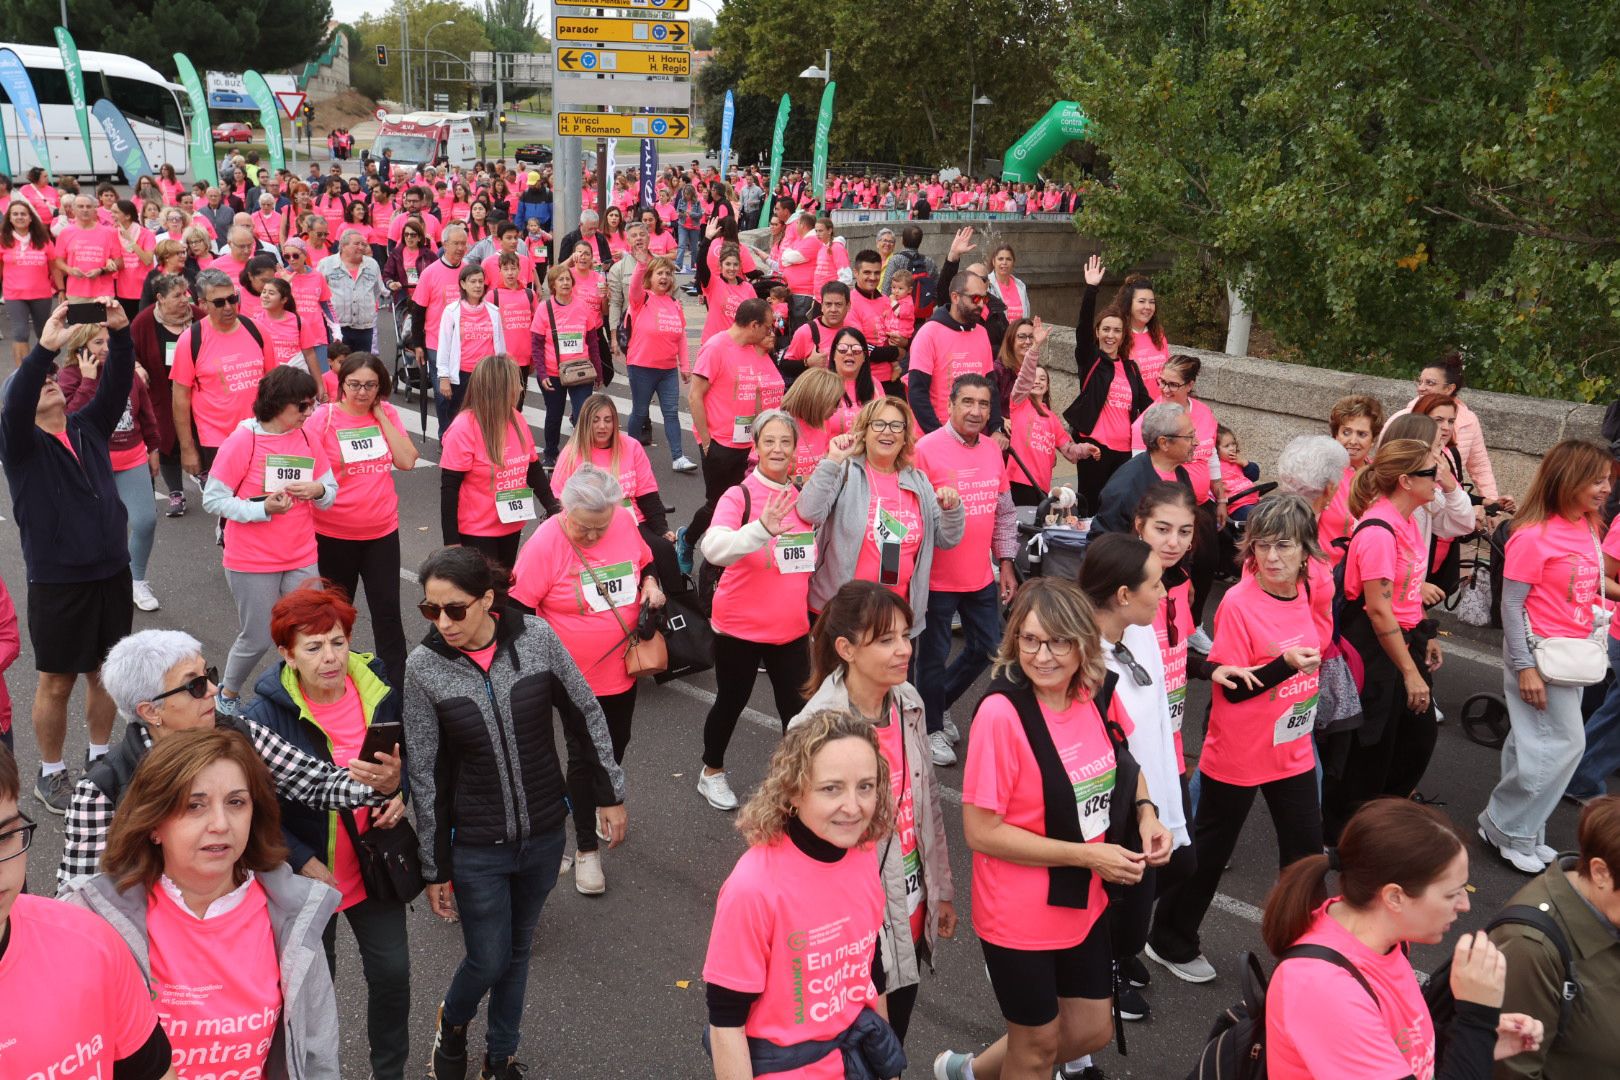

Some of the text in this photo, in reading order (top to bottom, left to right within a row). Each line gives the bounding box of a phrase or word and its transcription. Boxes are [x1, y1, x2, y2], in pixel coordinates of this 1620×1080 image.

[559, 25, 599, 34] parador
[661, 55, 687, 63] Horus
[662, 64, 687, 73] Regio
[573, 116, 599, 124] Vincci
[573, 125, 582, 133] P.
[585, 126, 621, 134] Romano
[223, 359, 264, 372] En march
[226, 370, 259, 381] contra
[229, 378, 261, 391] cánc
[1110, 391, 1132, 400] contr
[1109, 400, 1132, 410] cánc
[351, 438, 374, 451] 9137
[1031, 441, 1053, 455] cánc
[277, 468, 301, 480] 9138
[347, 461, 392, 475] cánce
[496, 465, 525, 479] contra
[958, 478, 999, 490] En march
[508, 500, 523, 511] 163
[783, 547, 806, 560] 6785
[1287, 711, 1312, 729] 8267
[1069, 769, 1081, 782] n
[1079, 750, 1115, 778] marc
[807, 951, 831, 972] En
[808, 960, 869, 994] contra
[792, 957, 804, 1025] SALAMANCA
[809, 979, 877, 1022] cánce
[172, 1041, 253, 1067] ontra
